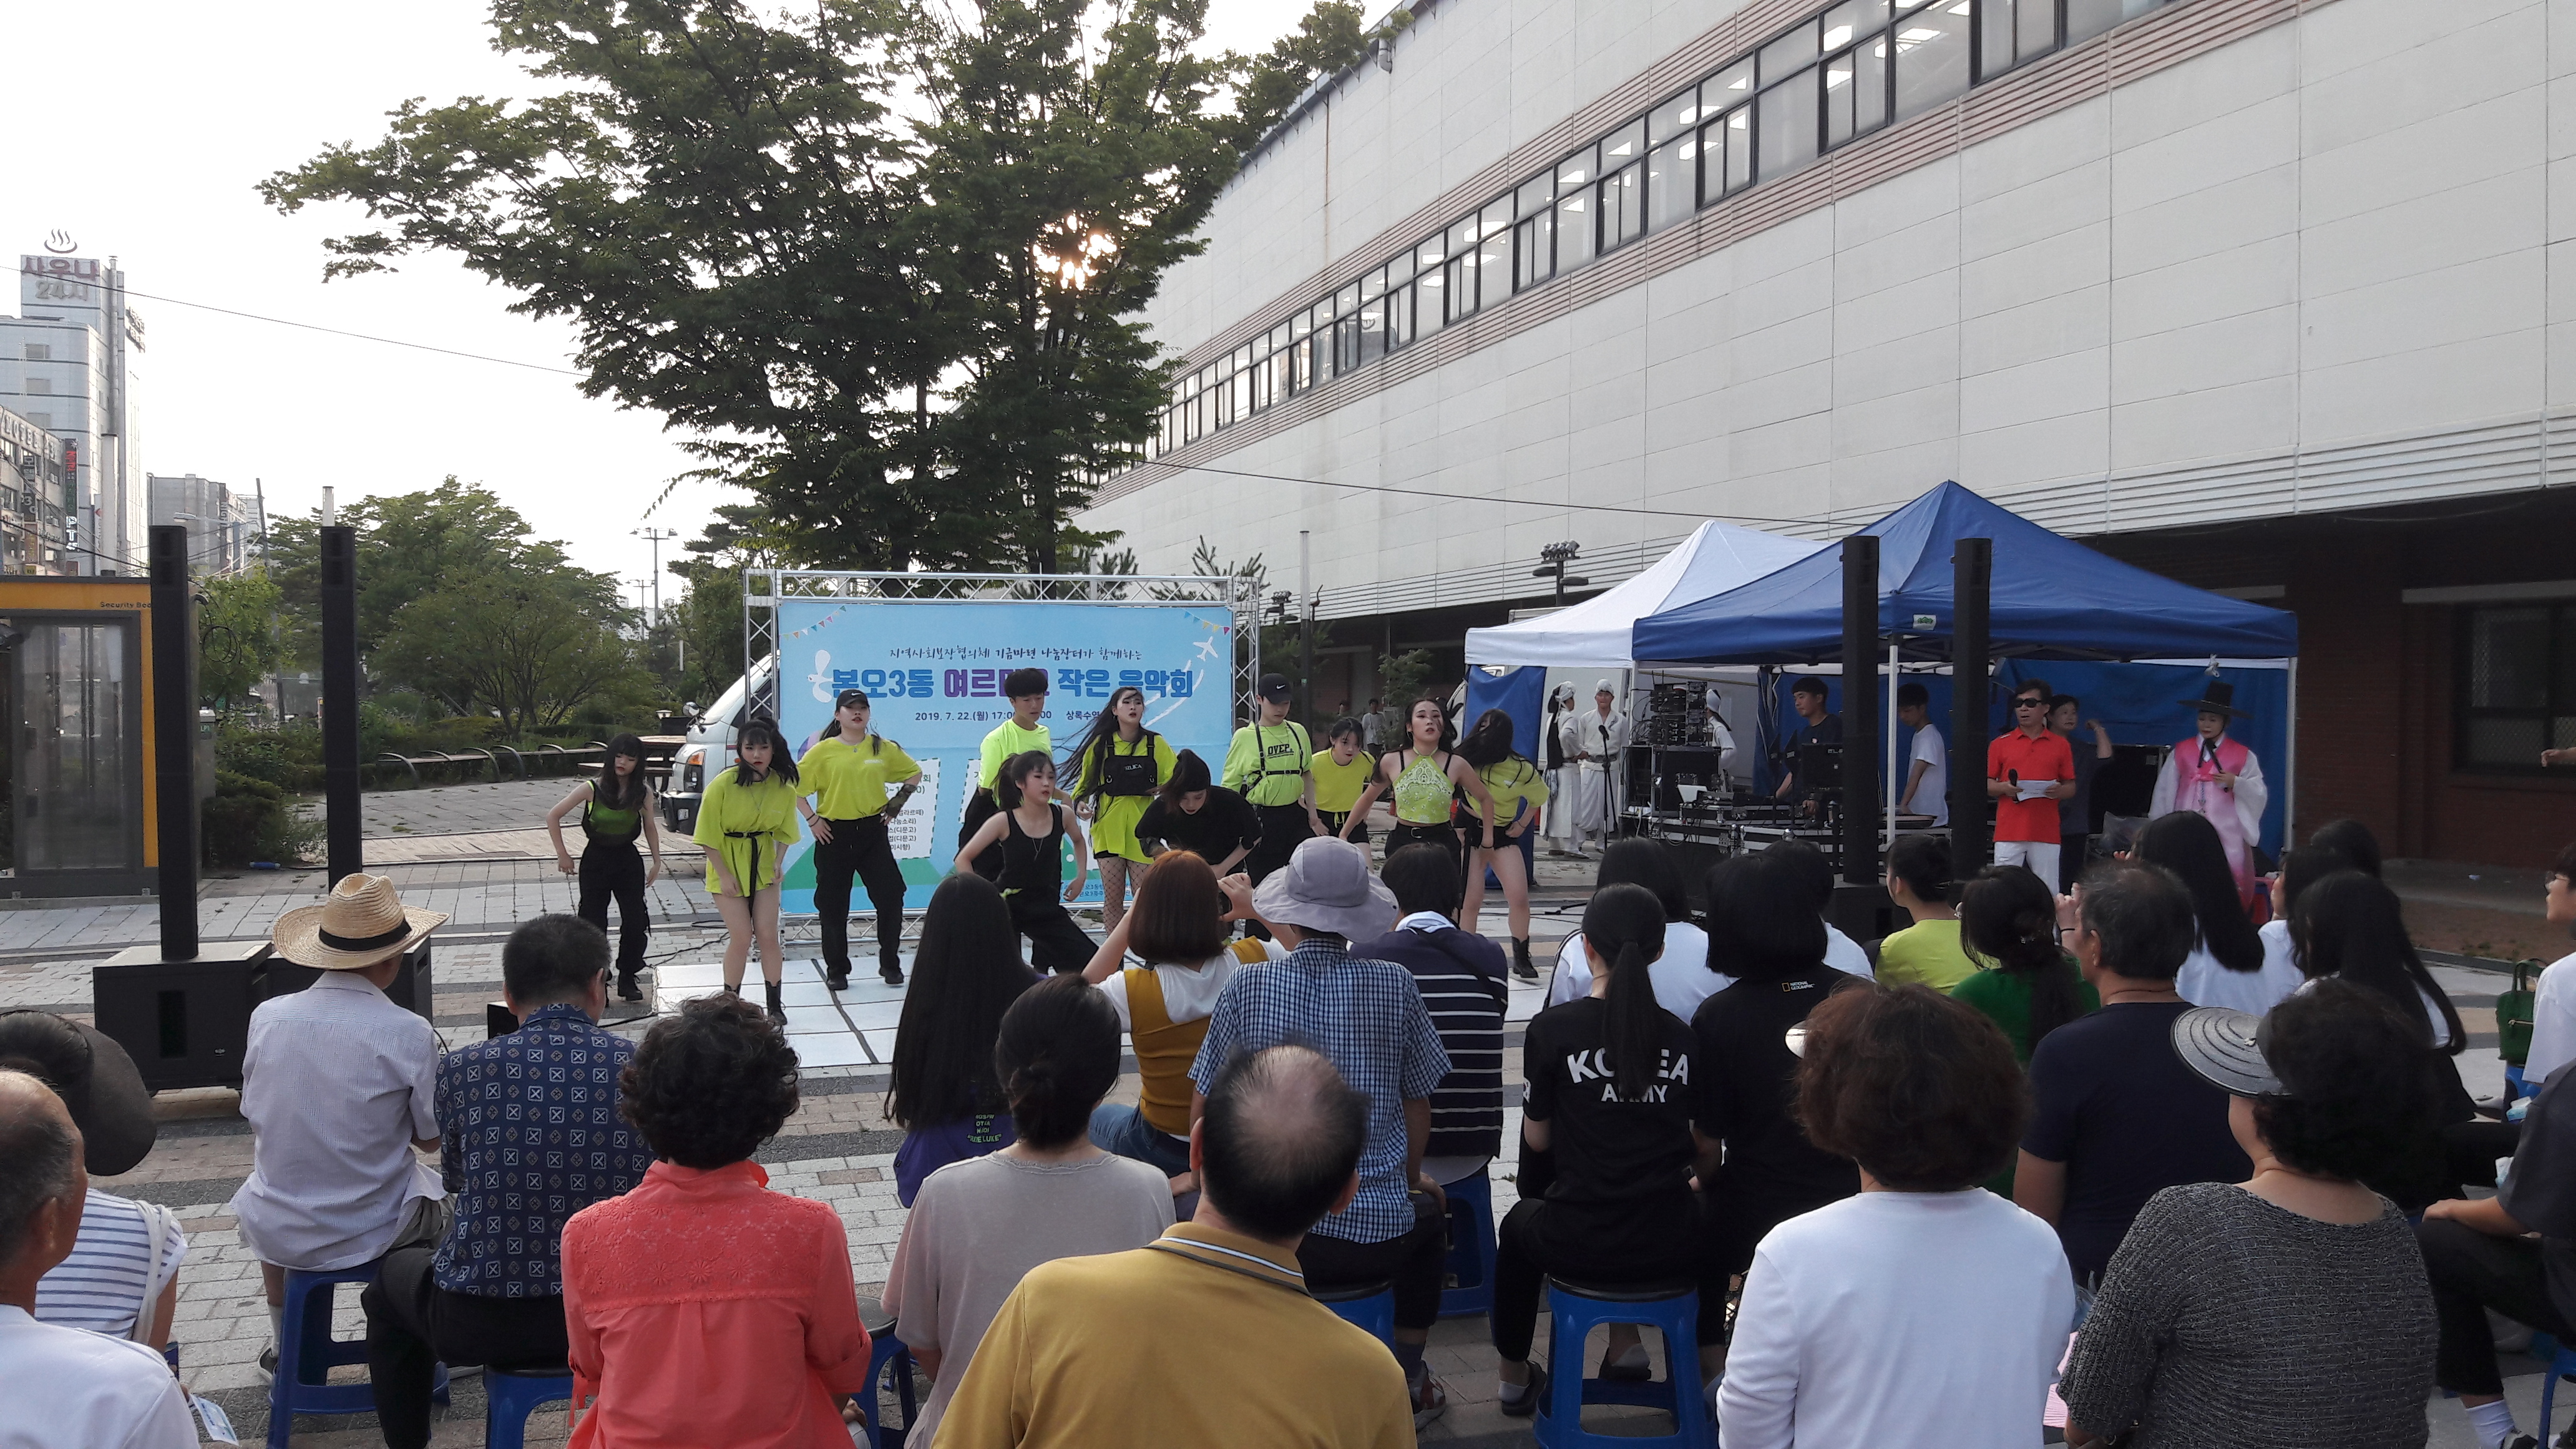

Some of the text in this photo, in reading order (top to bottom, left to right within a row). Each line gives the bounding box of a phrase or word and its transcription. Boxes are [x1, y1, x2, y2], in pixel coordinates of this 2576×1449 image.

[21, 257, 97, 280] 사우나
[35, 281, 87, 301] 24시
[890, 645, 1143, 661] 지역사회보장협의체 기금마련 나눔장터가 함께하는
[832, 669, 934, 698] 본오3동
[1058, 668, 1111, 697] 작은
[915, 712, 942, 721] 2019.
[945, 712, 955, 721] 7.
